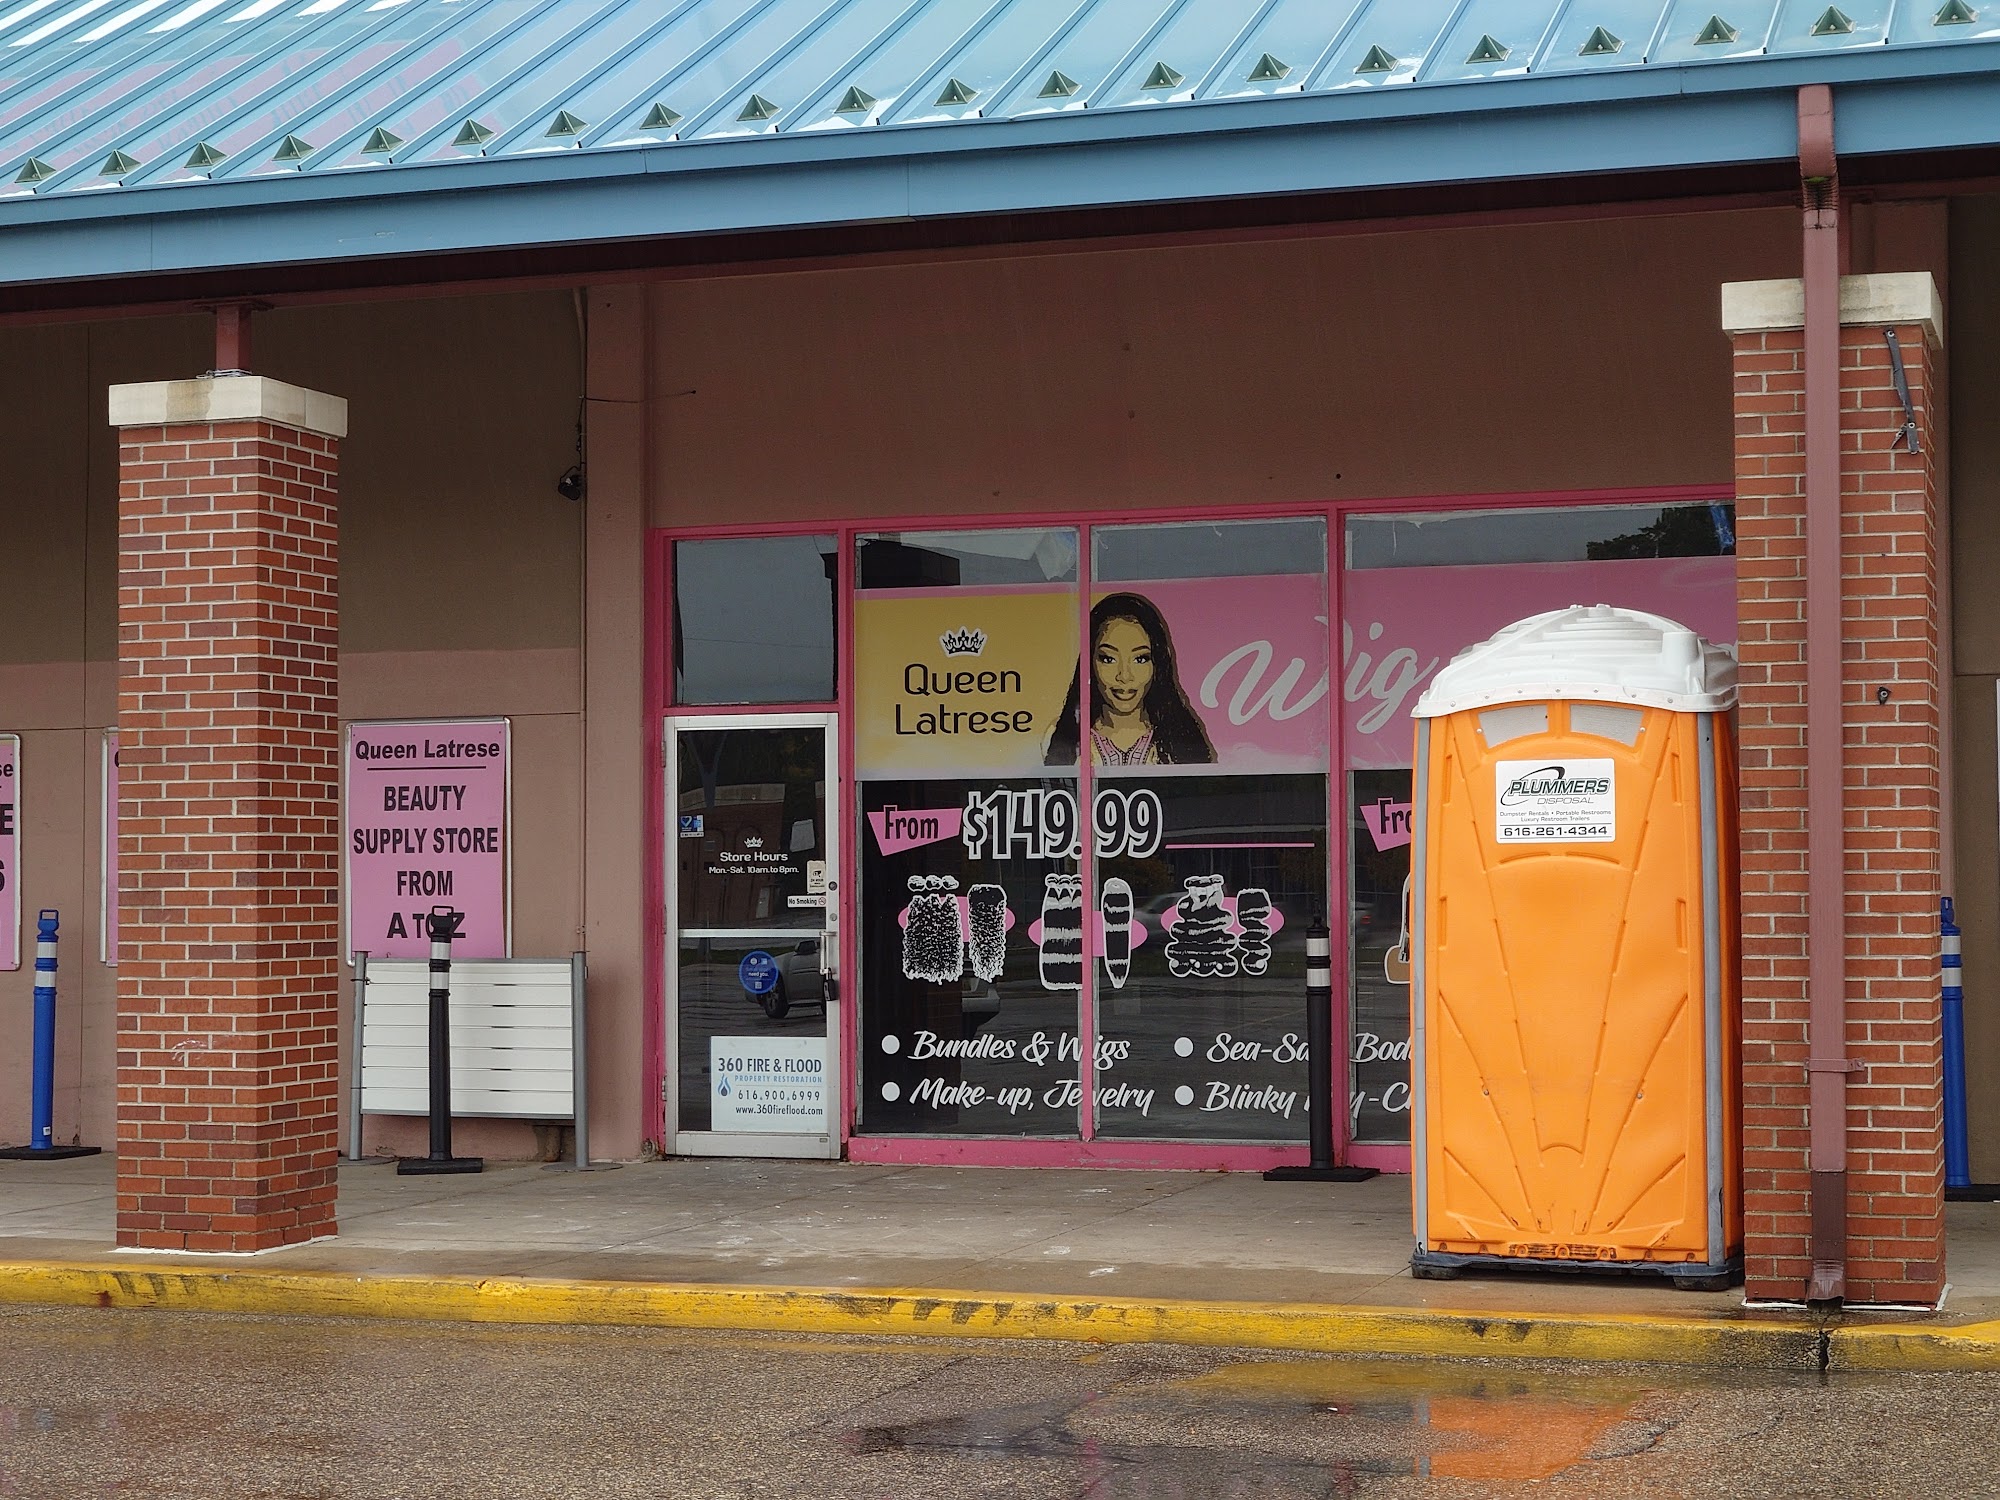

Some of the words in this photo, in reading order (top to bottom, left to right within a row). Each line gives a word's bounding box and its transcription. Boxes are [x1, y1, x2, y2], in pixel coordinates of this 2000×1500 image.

[903, 663, 1021, 697] Queen
[1200, 615, 1450, 734] Wig
[894, 704, 1033, 735] Latrese
[355, 740, 417, 760] Queen
[424, 739, 500, 758] Latrese
[384, 785, 466, 812] BEAUTY
[1508, 778, 1610, 796] PLUMMERS
[1537, 797, 1594, 805] DISPOSAL
[884, 806, 939, 840] From
[963, 789, 1163, 859] $149.99
[1504, 826, 1608, 837] 616-261-4344
[353, 828, 427, 854] SUPPLY
[433, 827, 498, 853] STORE
[719, 851, 751, 862] Store
[754, 851, 788, 862] Hours
[397, 870, 453, 896] FROM
[386, 912, 408, 938] A
[447, 912, 466, 938] Z
[907, 1030, 1017, 1060] Bundles
[1021, 1031, 1054, 1066] &
[1057, 1032, 1130, 1070] Wigs
[1206, 1032, 1309, 1063] Sea-Sa
[1349, 1032, 1412, 1063] Bod
[718, 1057, 743, 1072] 360
[747, 1058, 770, 1072] FIRE
[773, 1058, 782, 1072] &
[785, 1058, 822, 1073] FLOOD
[734, 1074, 770, 1082] PROPERTY
[774, 1075, 822, 1083] RESTORATION
[738, 1089, 820, 1101] 616.900.6999
[909, 1077, 1033, 1115] Make-up,
[1200, 1081, 1297, 1119] Blinky
[735, 1104, 823, 1115] www.360fireflood.com
